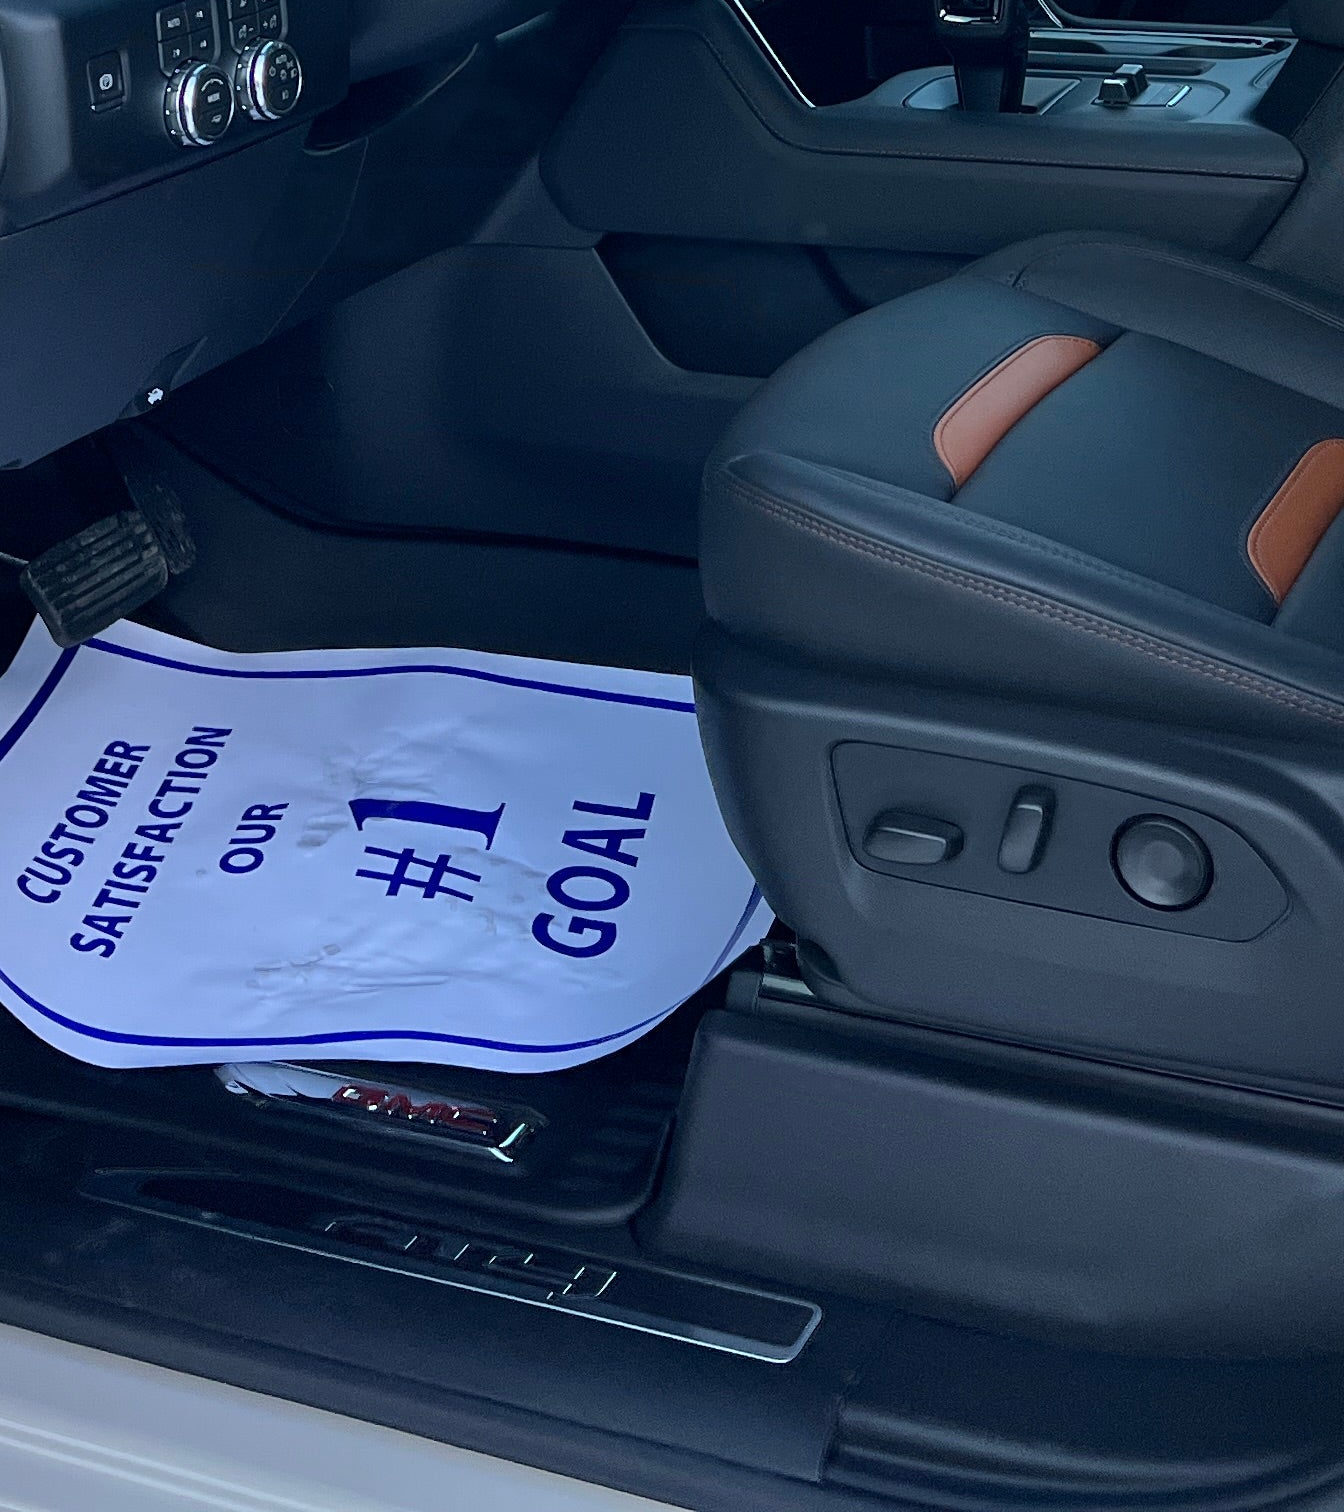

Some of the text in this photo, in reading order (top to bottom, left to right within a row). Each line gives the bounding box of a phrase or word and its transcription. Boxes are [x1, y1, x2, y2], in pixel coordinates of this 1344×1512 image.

[16, 740, 152, 904] CUSTOMER
[69, 725, 234, 959] SATISFACTION
[219, 802, 290, 875] OUR
[347, 796, 507, 903] #1
[531, 790, 656, 959] GOAL
[330, 1083, 499, 1138] GMC
